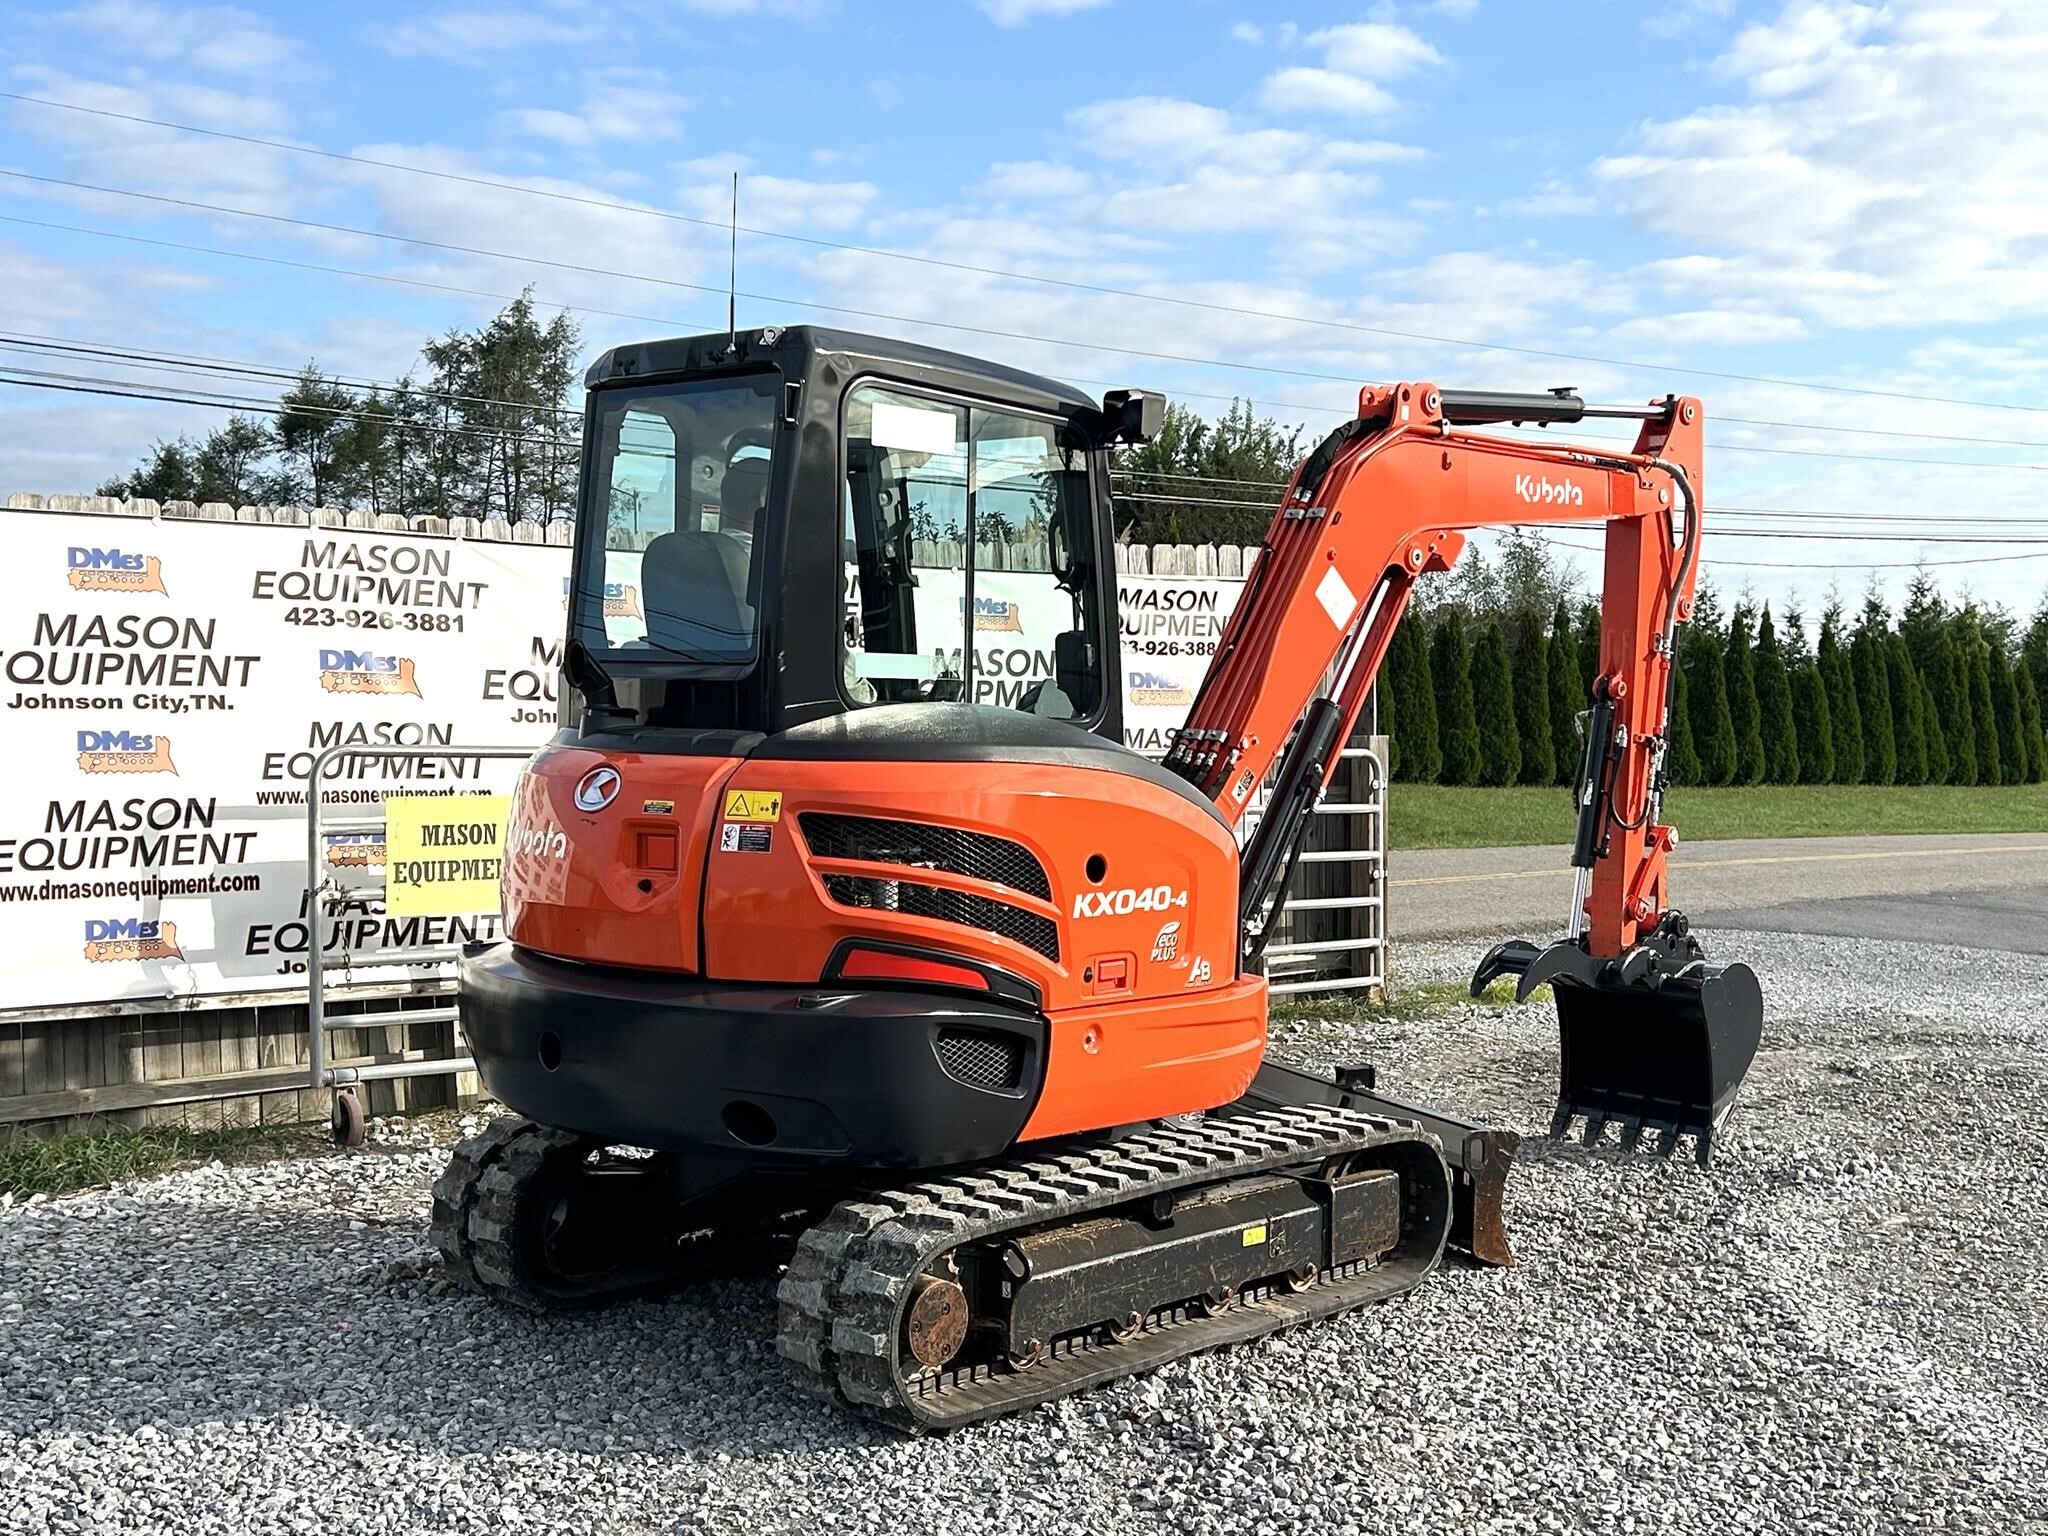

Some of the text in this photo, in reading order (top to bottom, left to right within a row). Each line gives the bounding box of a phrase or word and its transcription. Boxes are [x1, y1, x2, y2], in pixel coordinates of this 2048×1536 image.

[1515, 473, 1583, 506] Kubota
[300, 539, 450, 577] MASON
[252, 571, 489, 609] EQUIPMENT
[1119, 587, 1218, 613] MASON
[33, 613, 216, 650] MASON
[284, 606, 465, 633] 423-926-3881
[1119, 613, 1228, 637] UIPMEN
[1121, 640, 1216, 656] 3-926-388
[0, 650, 261, 687] QUIPMENT
[7, 692, 234, 713] Johnson City,TN.
[308, 721, 452, 748] MASON
[1125, 727, 1176, 749] MAS
[261, 752, 483, 780] EQUIPMENT
[44, 797, 216, 833] MASON
[421, 823, 497, 847] MASON
[0, 832, 258, 872] EQUIPMENT
[393, 859, 502, 888] EQUIPME
[0, 874, 261, 903] ww.dmasonequipment.com
[1072, 885, 1188, 919] KX040-4
[1150, 947, 1177, 962] PLUS
[1158, 934, 1178, 948] eco
